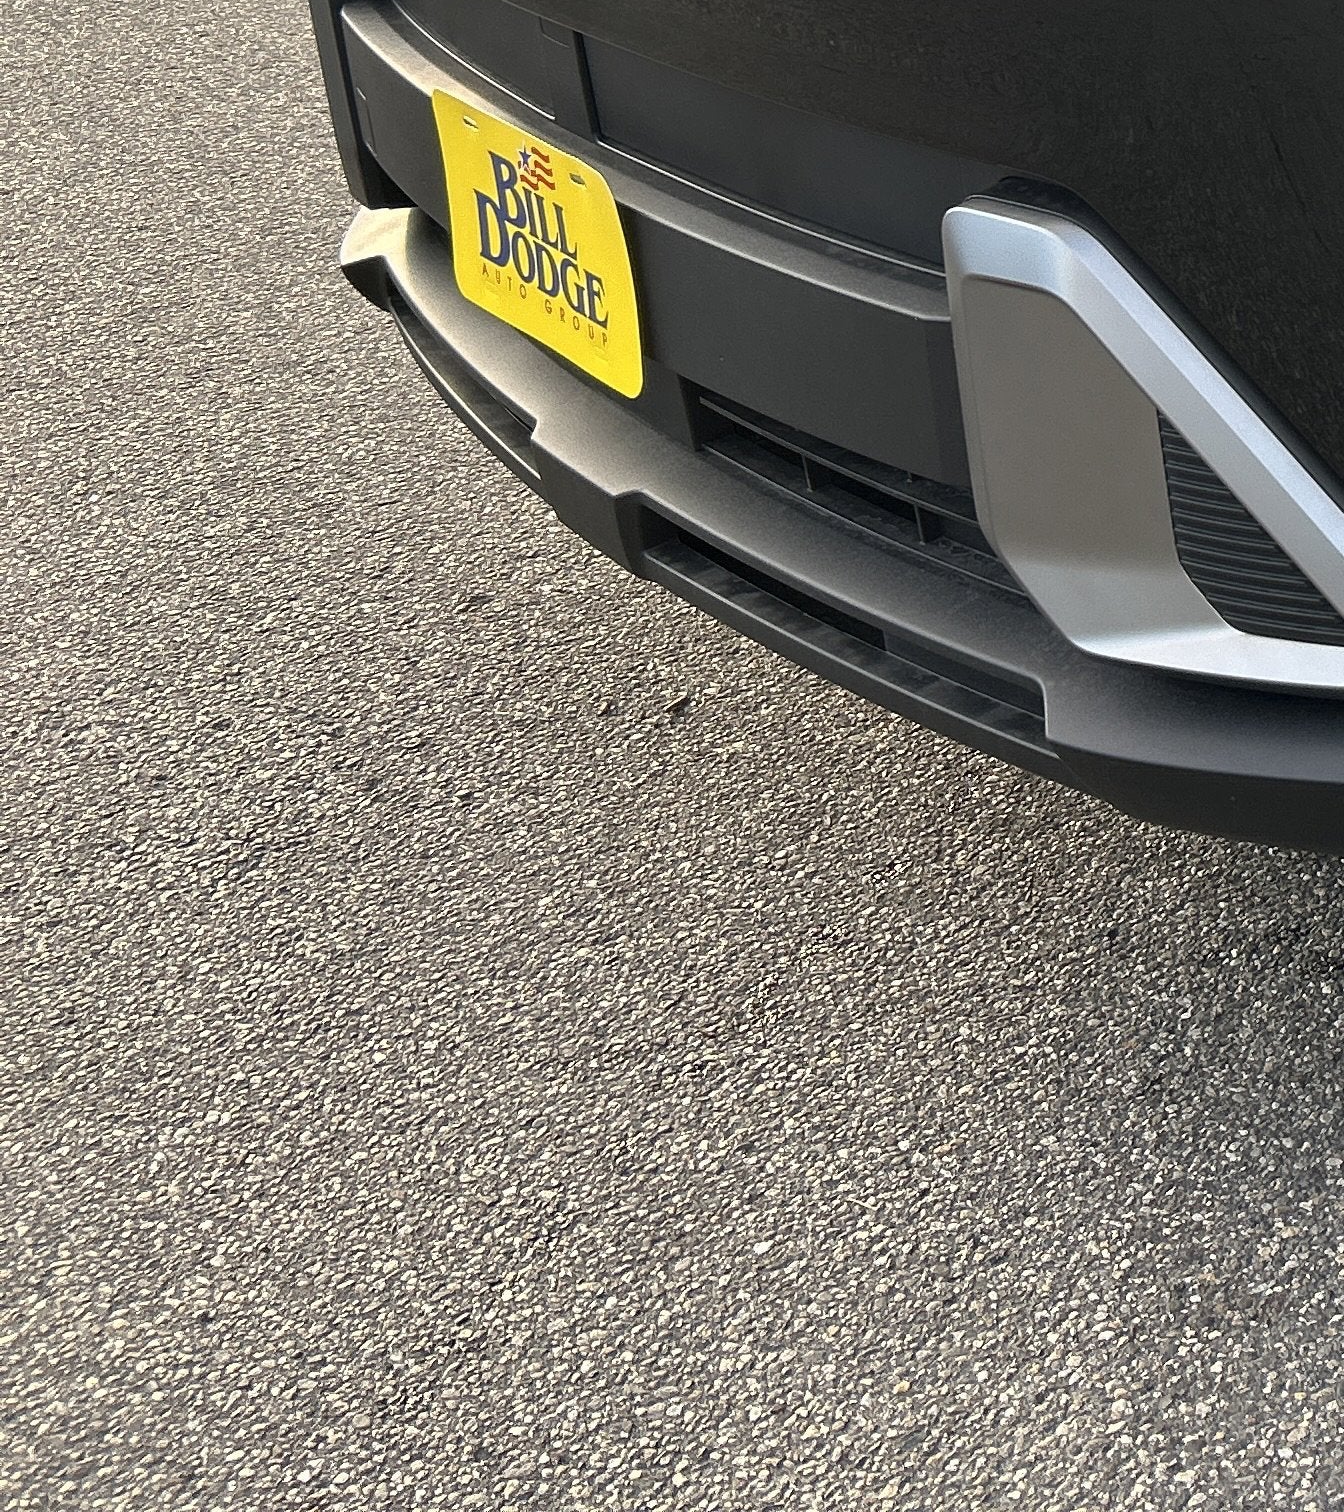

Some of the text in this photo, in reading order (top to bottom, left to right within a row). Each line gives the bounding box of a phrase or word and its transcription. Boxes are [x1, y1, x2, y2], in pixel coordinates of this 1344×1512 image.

[473, 188, 609, 329] DODGE
[488, 150, 578, 259] BILL
[481, 264, 609, 348] AUTO GROUP
